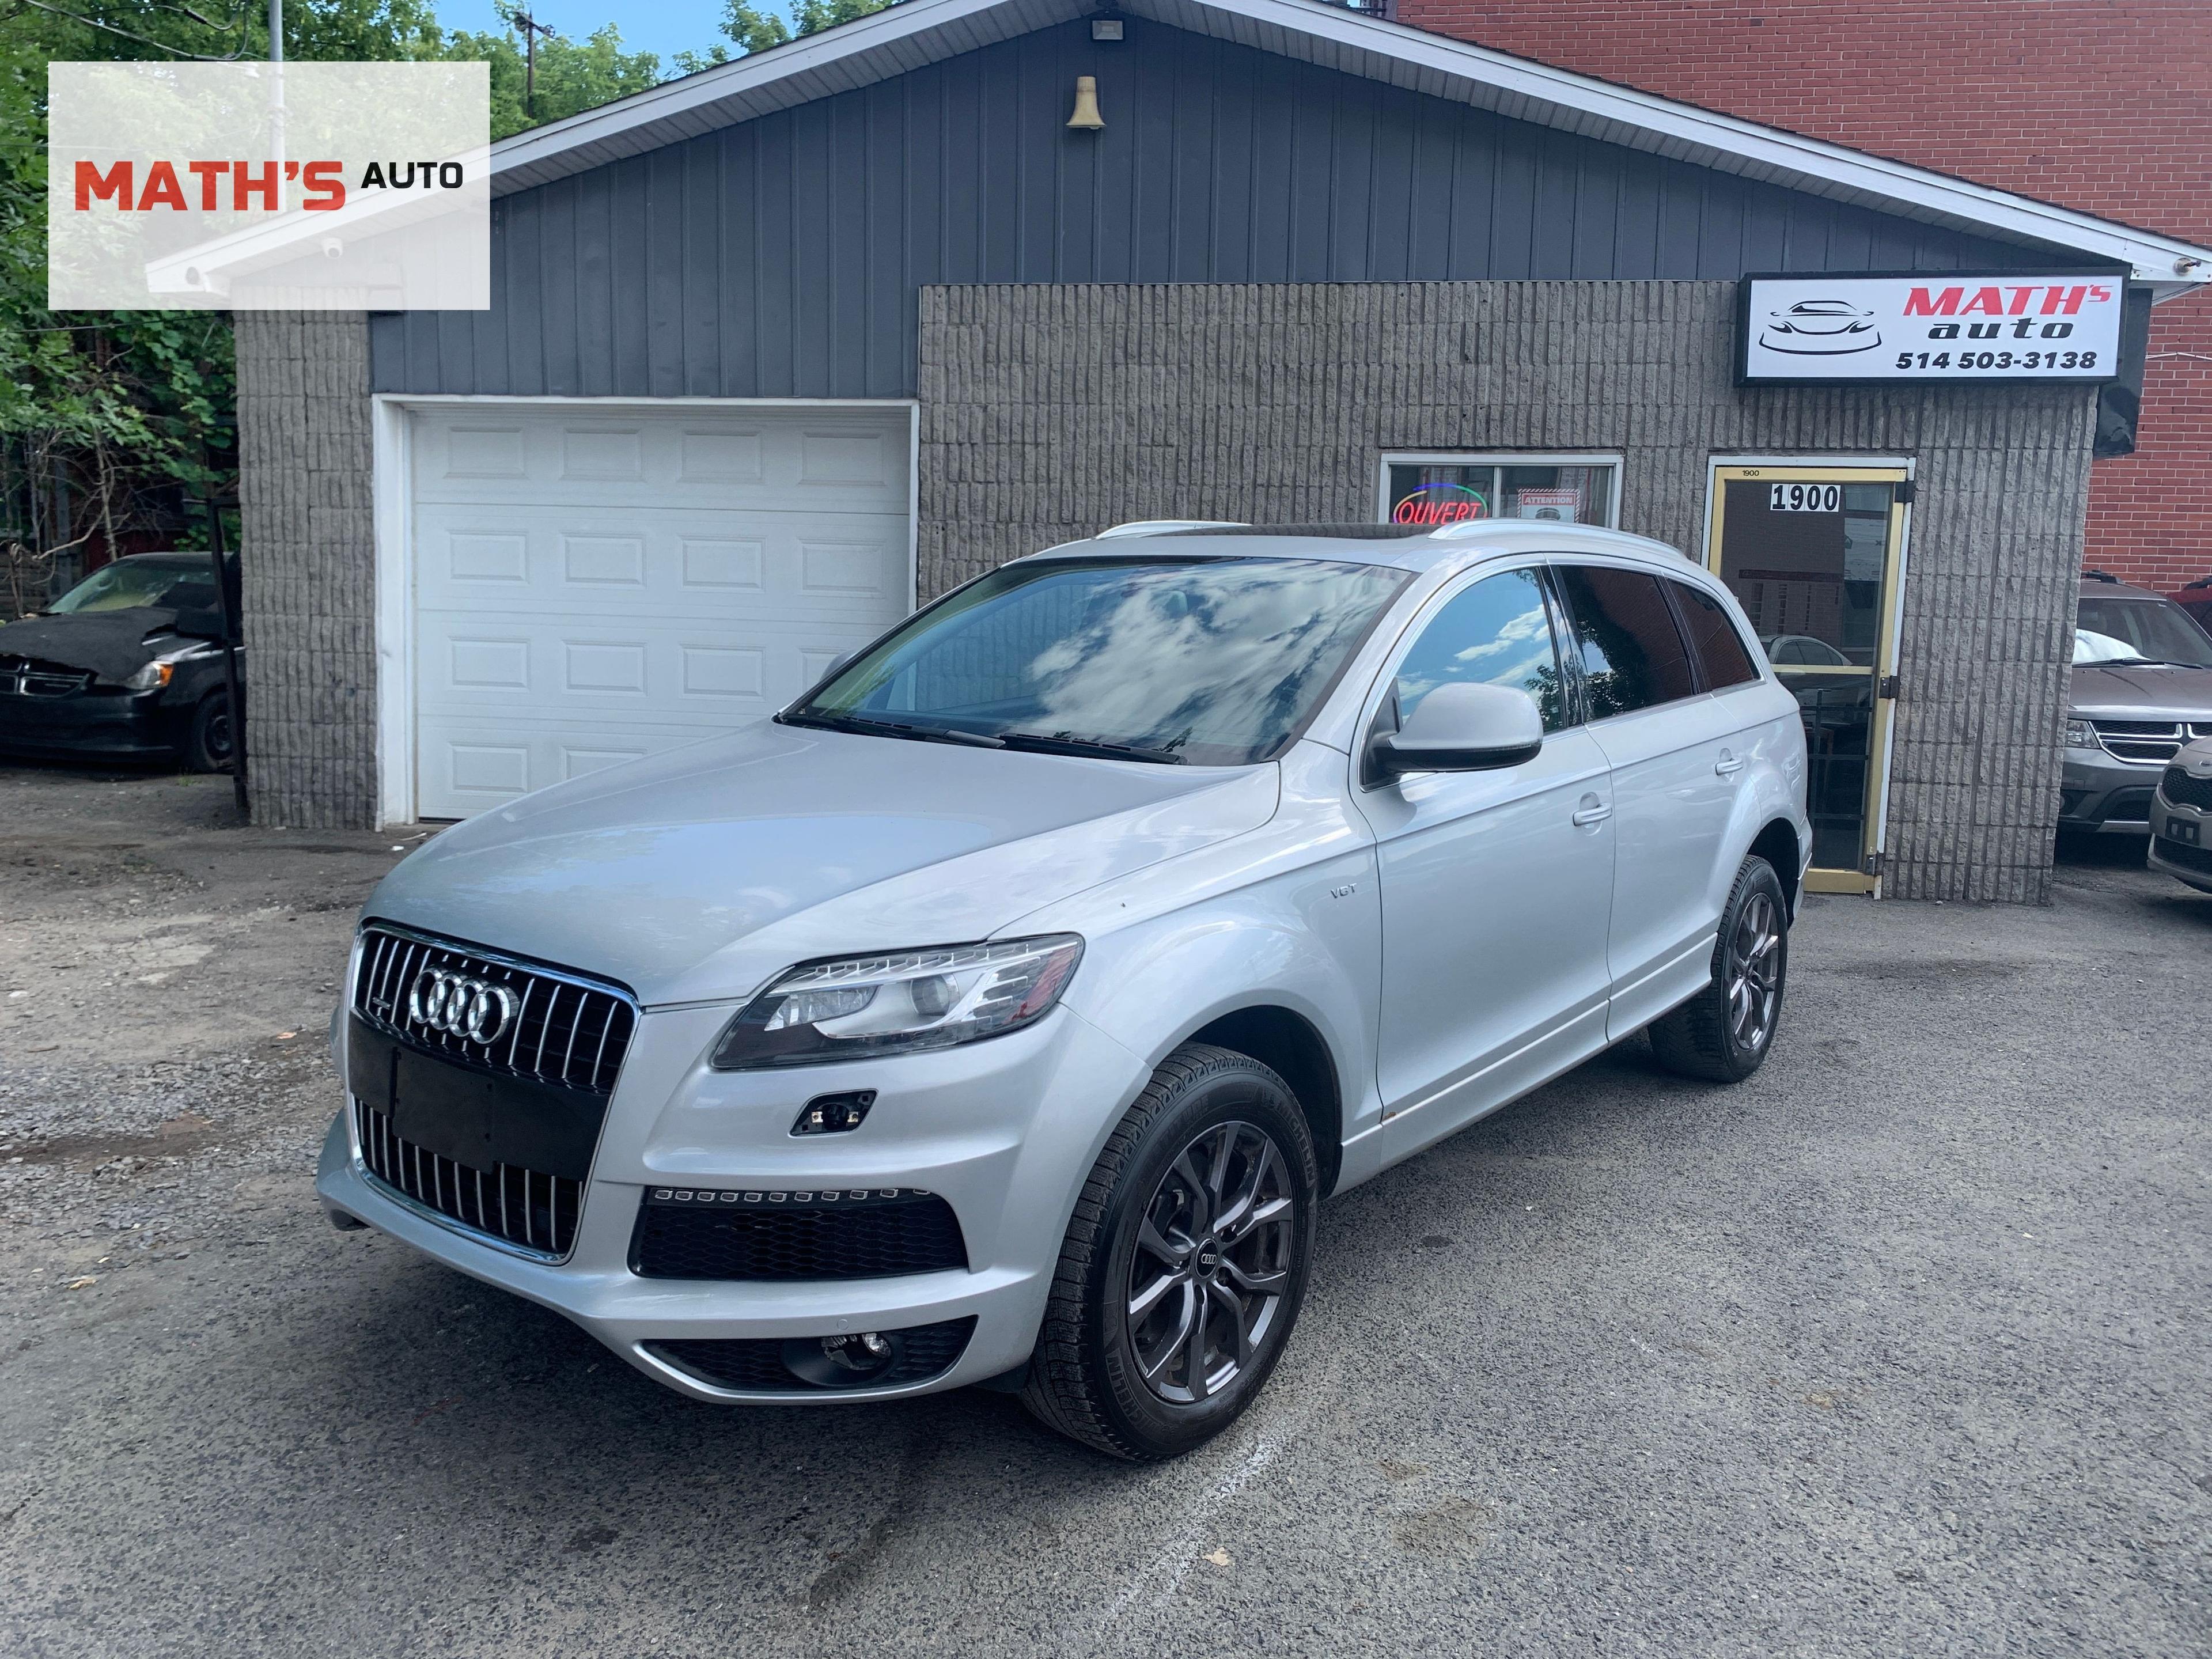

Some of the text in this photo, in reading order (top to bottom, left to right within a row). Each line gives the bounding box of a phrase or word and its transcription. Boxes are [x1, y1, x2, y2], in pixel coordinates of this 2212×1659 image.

[1927, 317, 2074, 339] auto
[1896, 351, 2097, 369] 514 503-3138
[1524, 495, 1573, 505] ATTENTION
[1772, 484, 1839, 511] 1900
[1399, 502, 1482, 525] OUVERT
